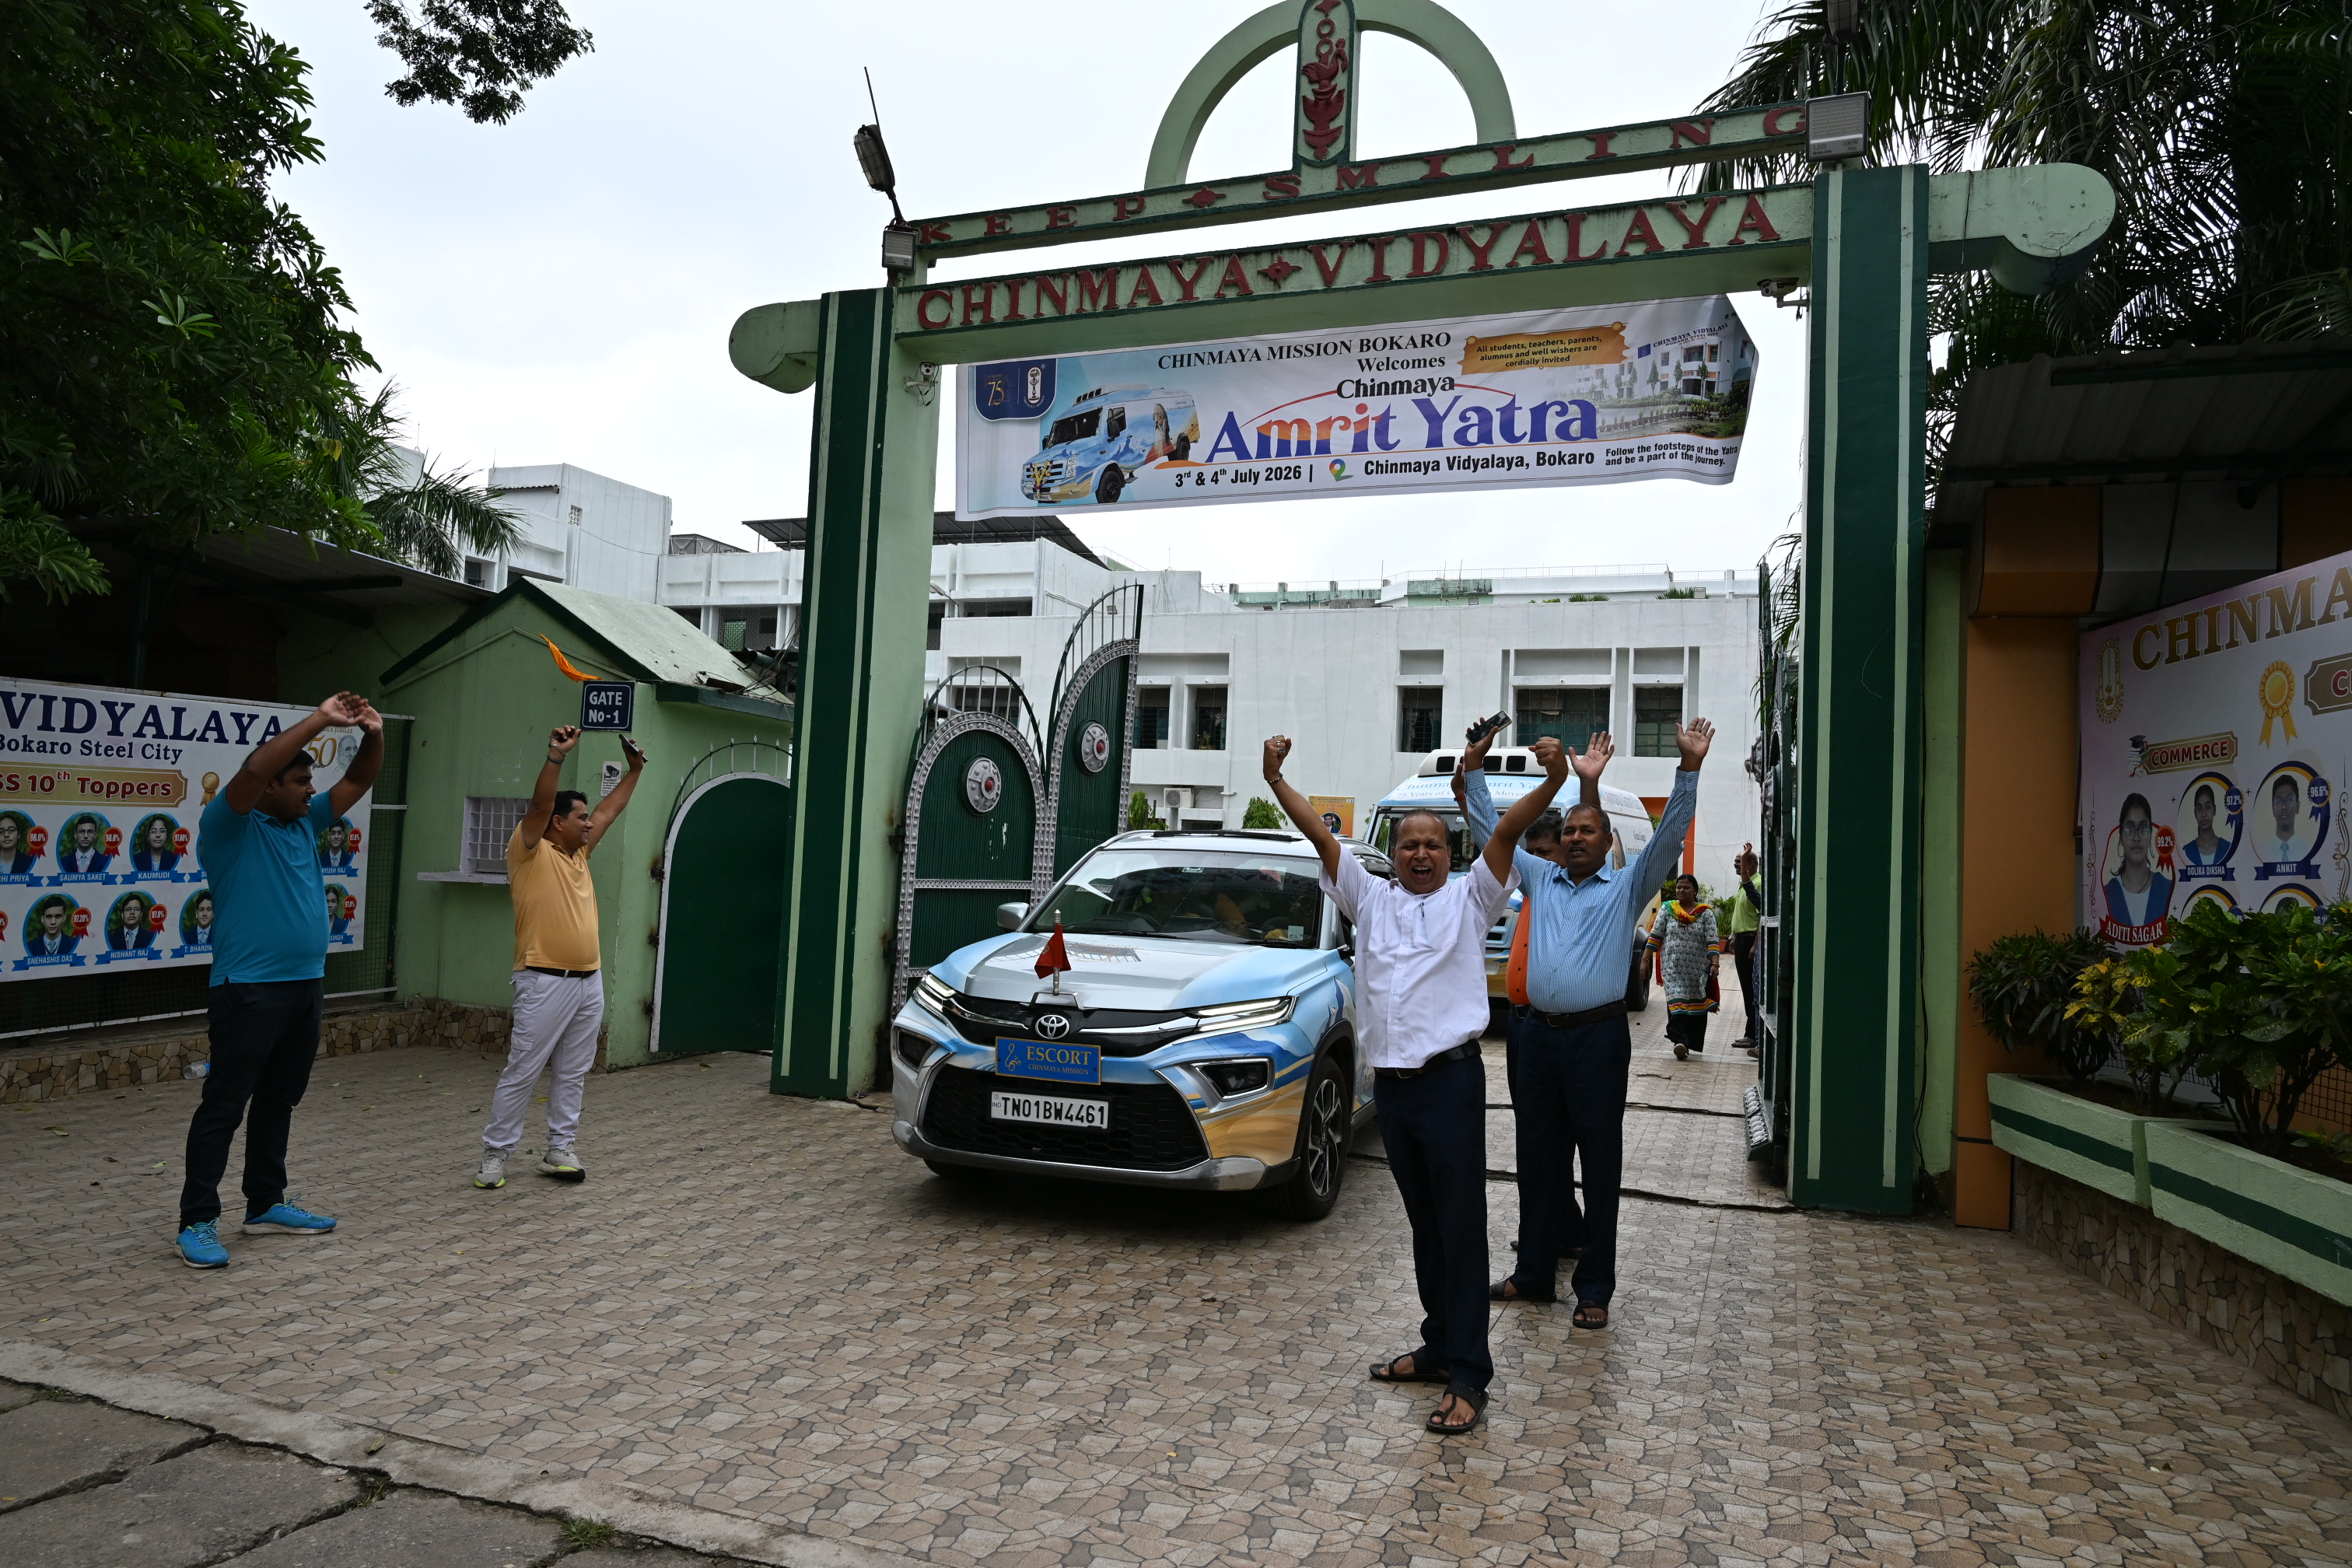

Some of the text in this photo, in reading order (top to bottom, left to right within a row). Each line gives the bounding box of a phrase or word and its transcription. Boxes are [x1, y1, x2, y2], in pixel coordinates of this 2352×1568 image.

[920, 106, 1806, 243] KEEP SMILING
[918, 192, 1781, 330] CHINMAYA VIDYALAYA
[1489, 341, 1527, 352] students,
[1528, 338, 1566, 350] teachers,
[1567, 334, 1602, 346] parents,
[1653, 323, 1728, 348] CHINMAYA VIDYALAYA
[1157, 332, 1451, 369] CHINMAYA MISSION BOKARO
[1479, 352, 1514, 362] alumnus
[1515, 349, 1530, 359] and
[1531, 348, 1549, 356] well
[1549, 345, 1582, 355] wishers
[1356, 354, 1447, 373] Welcomes
[1505, 355, 1570, 368] cordially invited
[1336, 375, 1455, 399] Chinmaya
[1205, 392, 1598, 464] Amrit Yatra
[1605, 441, 1738, 457] Follow the footsteps of the Yatra
[1363, 450, 1595, 476] Chinmaya Vidyalaya, Bokaro
[1605, 457, 1622, 466] and
[1625, 455, 1636, 464] be
[1647, 452, 1666, 464] part
[1668, 451, 1678, 460] of
[1681, 451, 1693, 461] the
[1695, 453, 1725, 467] journey.
[1175, 464, 1302, 488] 3rd & 4th July 2026
[2131, 565, 2352, 672] CHINMA
[589, 691, 623, 705] GATE
[0, 691, 282, 747] VIDYALAYA
[80, 738, 135, 759] Steel
[141, 741, 184, 765] City
[308, 734, 338, 768] 50
[2151, 739, 2228, 767] COMMERCE
[28, 770, 71, 794] 10th
[77, 777, 172, 800] Toppers
[2310, 785, 2329, 797] 96.6%
[2226, 794, 2242, 806] 97.2%
[30, 833, 46, 842] 98.0%
[105, 833, 121, 842] 98.0%
[2157, 835, 2173, 849] 99.2%
[2186, 865, 2226, 876] DOLIKA DIKSHA
[2276, 863, 2298, 873] ANKIT
[10, 874, 30, 883] PRIYA
[73, 913, 89, 923] 97.20%
[151, 909, 165, 919] 97.0%
[2105, 922, 2163, 943] ADITI SAGAR
[191, 943, 212, 954] BHARDW
[27, 954, 73, 965] SNEHASHIS DAS
[1026, 1045, 1092, 1066] ESCORT
[1028, 1063, 1090, 1076] CHINMAYA MISSION
[1001, 1096, 1104, 1125] TN01BW4461
